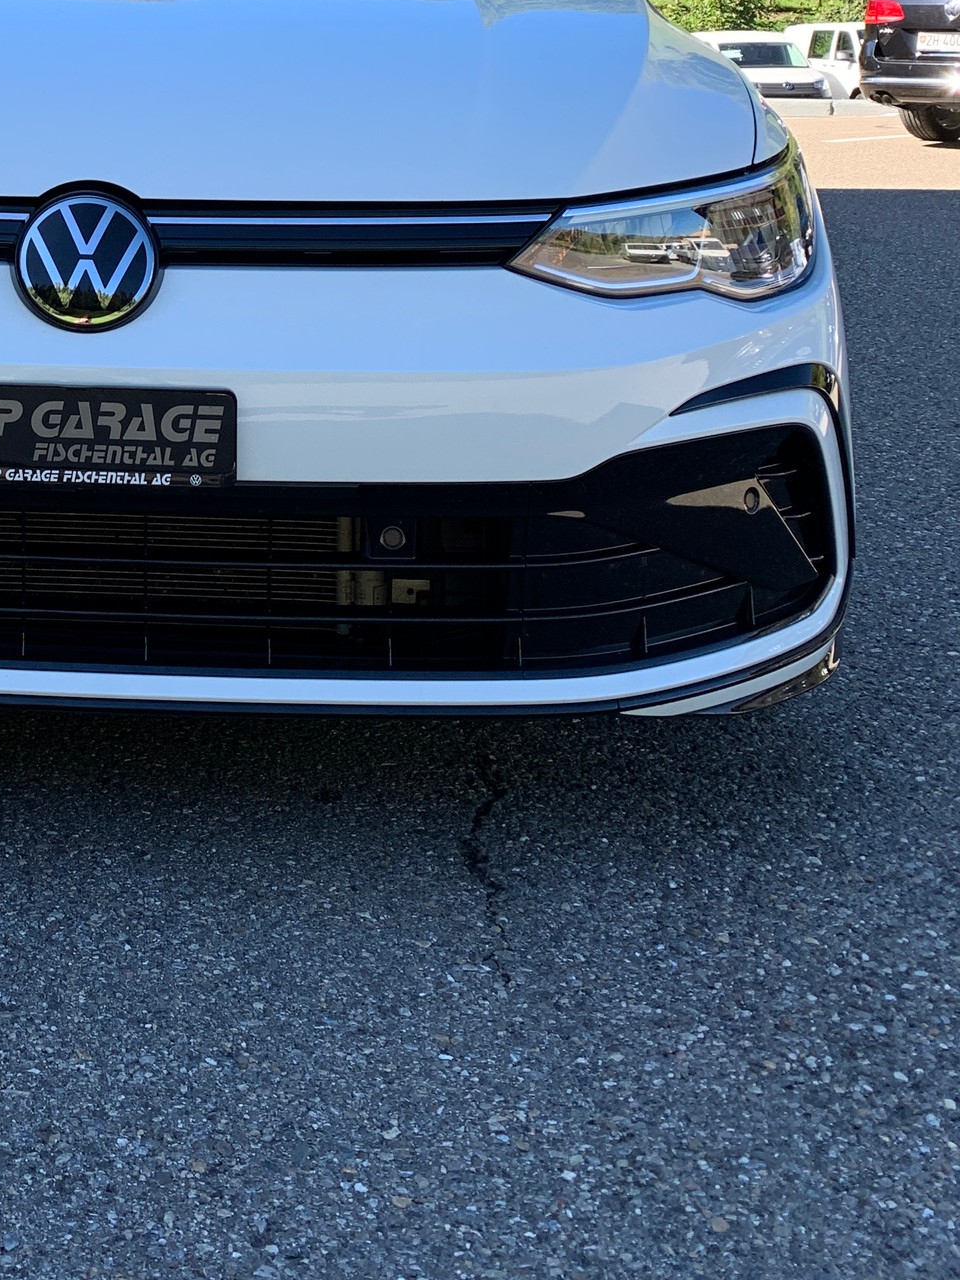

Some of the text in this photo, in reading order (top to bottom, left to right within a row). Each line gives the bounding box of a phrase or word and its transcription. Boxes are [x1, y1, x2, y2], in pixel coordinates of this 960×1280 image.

[31, 400, 225, 444] GARAGE
[32, 442, 217, 468] FISCHENTHAL AG
[5, 468, 60, 483] GARAGE
[62, 470, 148, 485] FISCHENTHAL
[151, 473, 172, 486] AG
